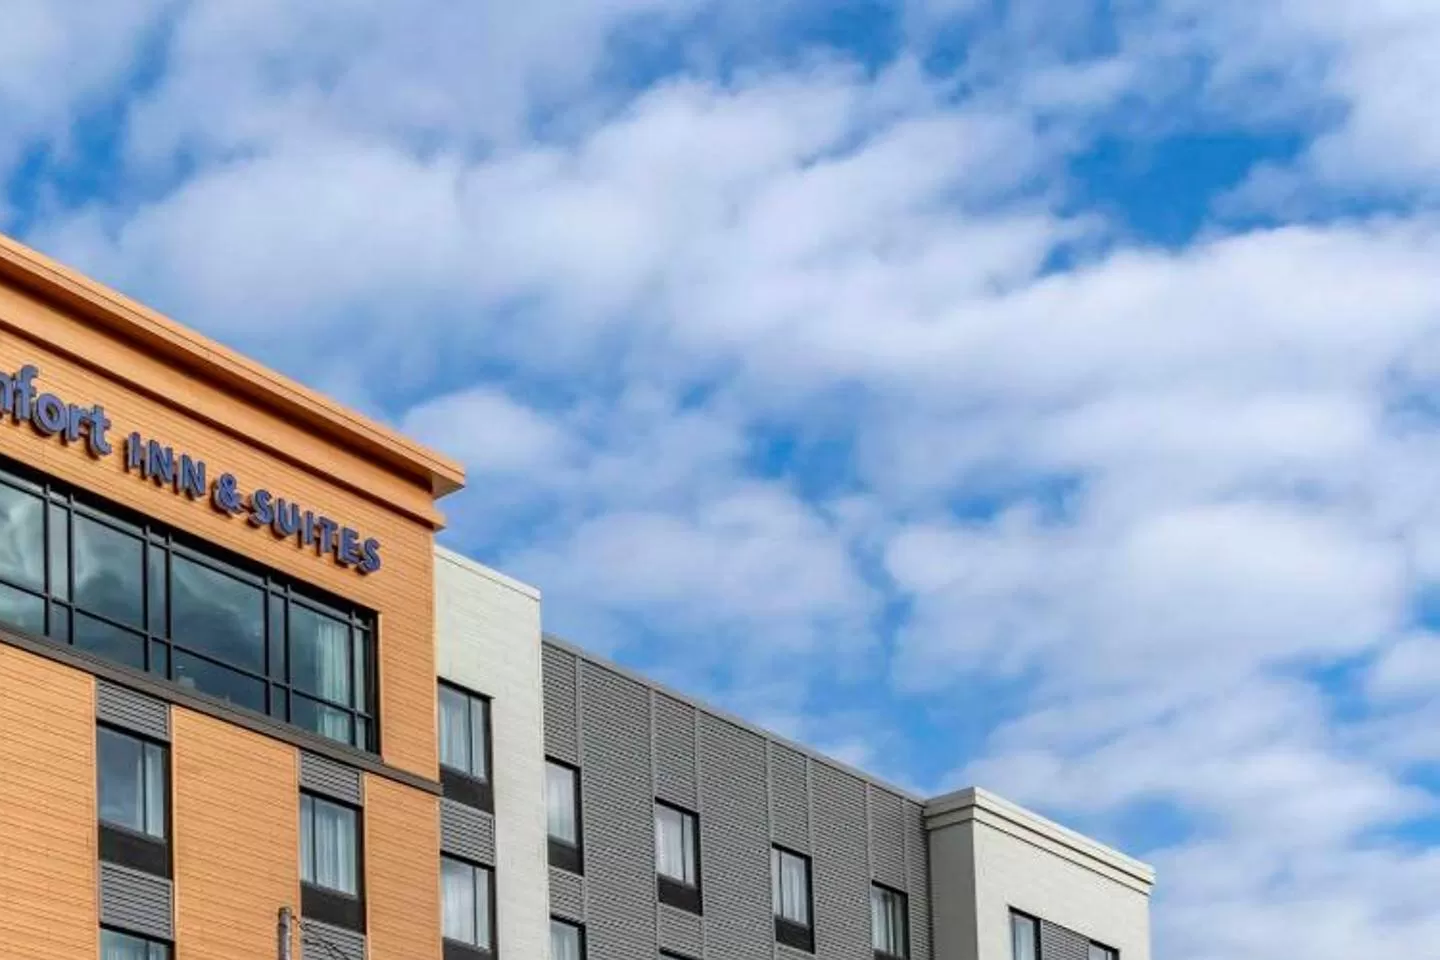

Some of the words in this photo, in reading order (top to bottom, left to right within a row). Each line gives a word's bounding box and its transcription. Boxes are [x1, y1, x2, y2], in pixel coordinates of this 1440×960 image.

[127, 431, 206, 498] INN
[215, 473, 245, 515] &
[250, 489, 382, 574] SUITES
